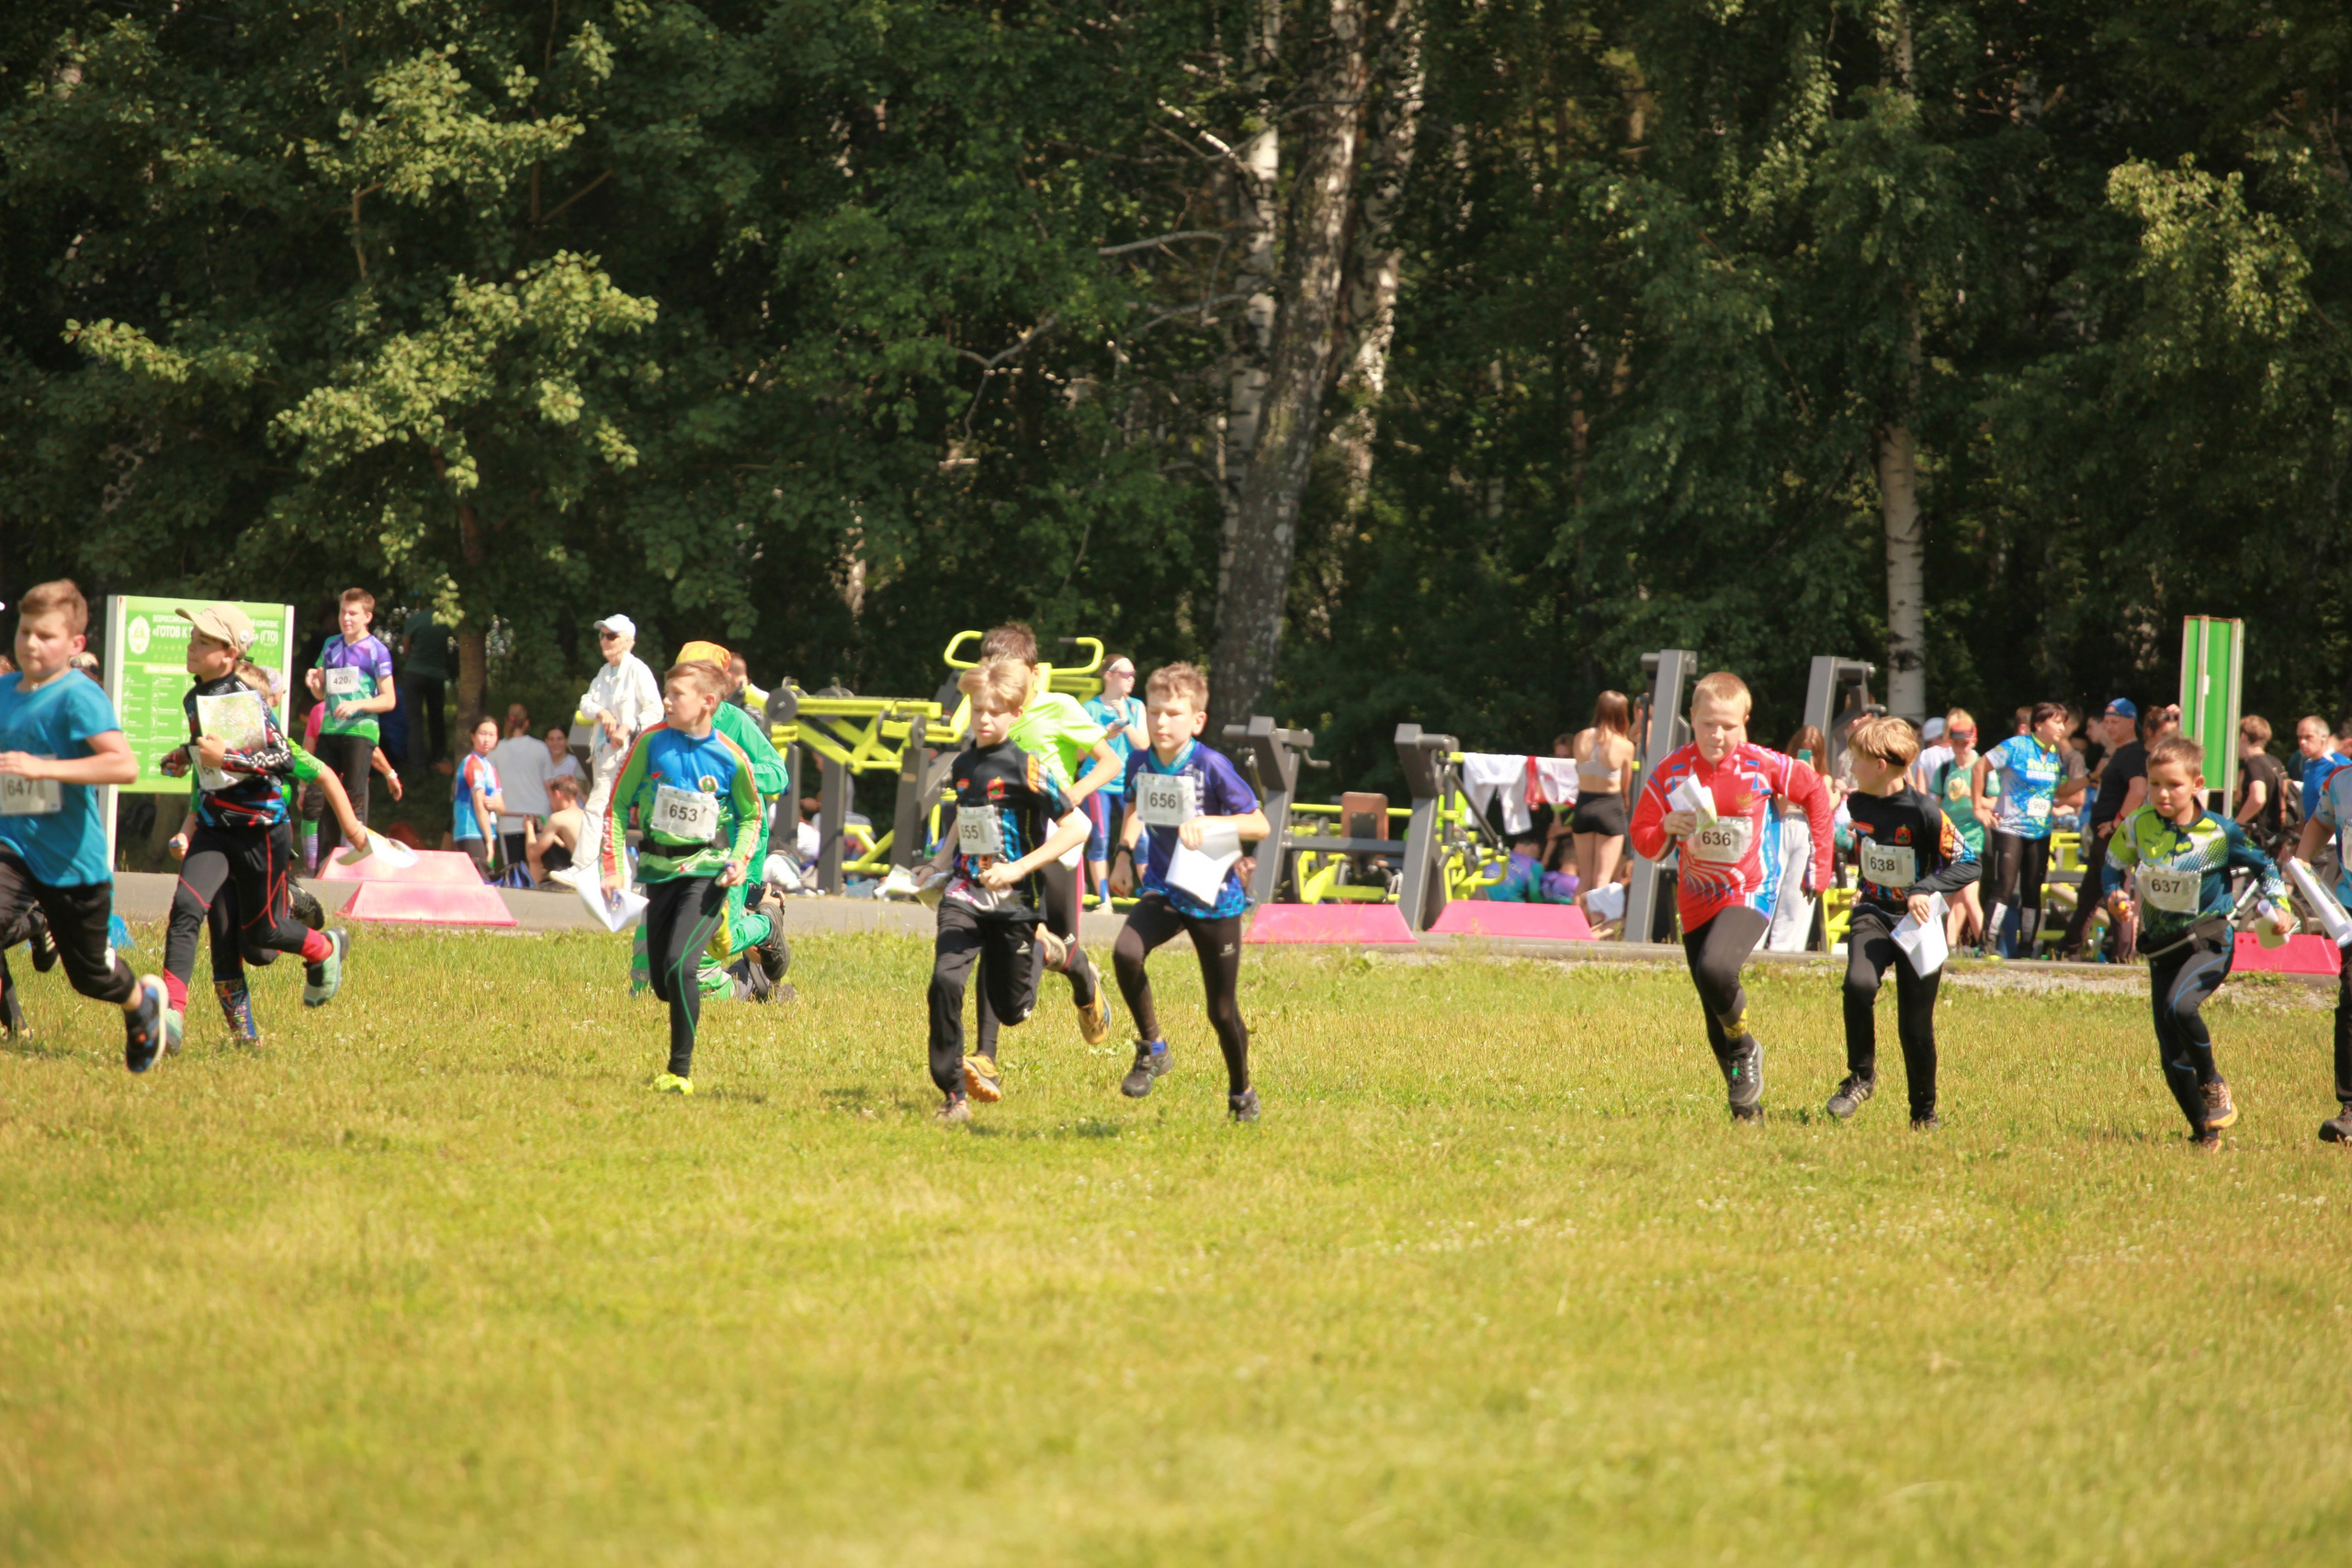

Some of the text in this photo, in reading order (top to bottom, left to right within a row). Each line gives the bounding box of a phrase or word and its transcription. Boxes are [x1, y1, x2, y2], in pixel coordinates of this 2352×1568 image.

[7, 777, 33, 796] 647
[1149, 792, 1176, 808] 656
[669, 804, 697, 822] 653
[1702, 830, 1731, 846] 636
[1871, 856, 1895, 872] 638
[2152, 878, 2180, 894] 637
